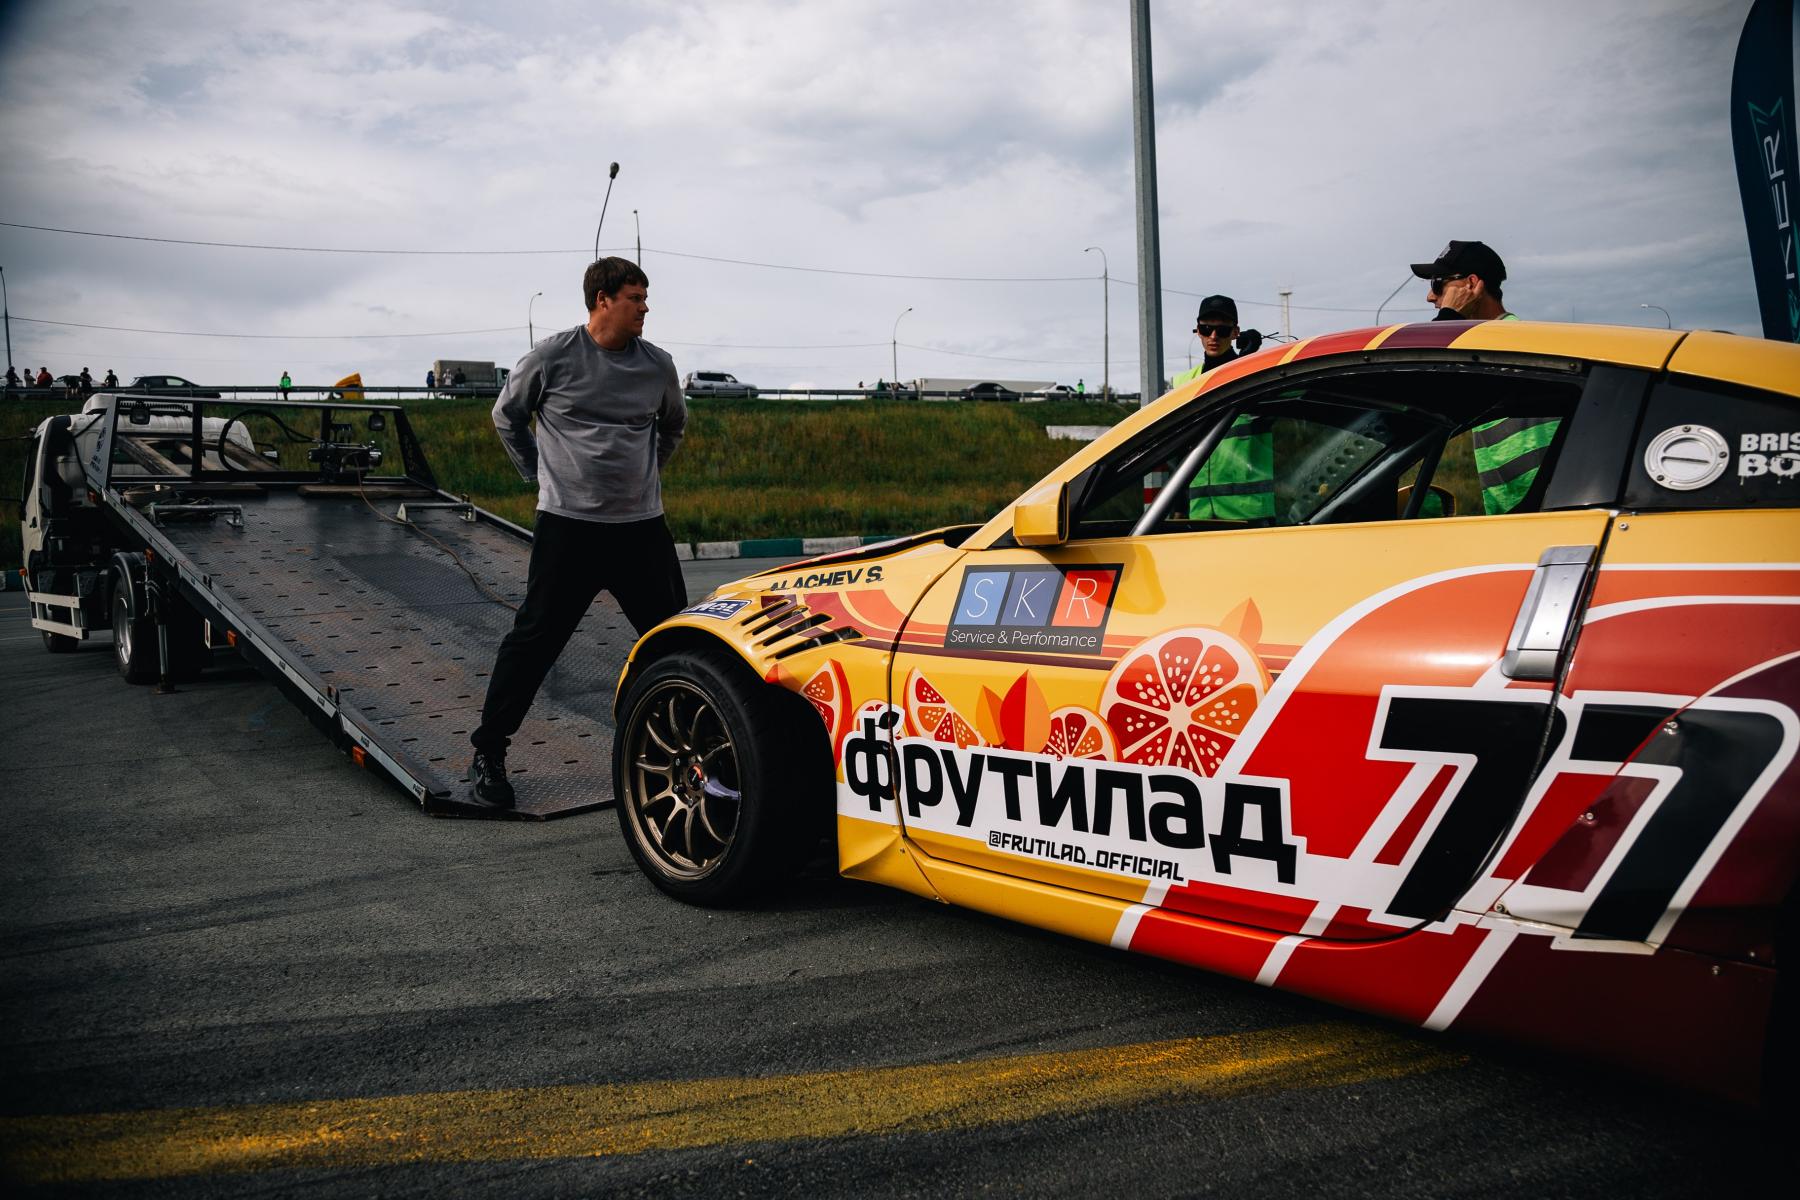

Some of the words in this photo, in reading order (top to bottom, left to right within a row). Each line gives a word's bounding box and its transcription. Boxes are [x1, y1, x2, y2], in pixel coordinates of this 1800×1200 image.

[966, 577, 1098, 620] SKR
[950, 629, 995, 645] Service
[997, 630, 1008, 645] &
[1011, 630, 1098, 648] Perfomance
[1379, 696, 1786, 940] 77
[989, 830, 1185, 882] @FRUTILAD_OFFICIAL
